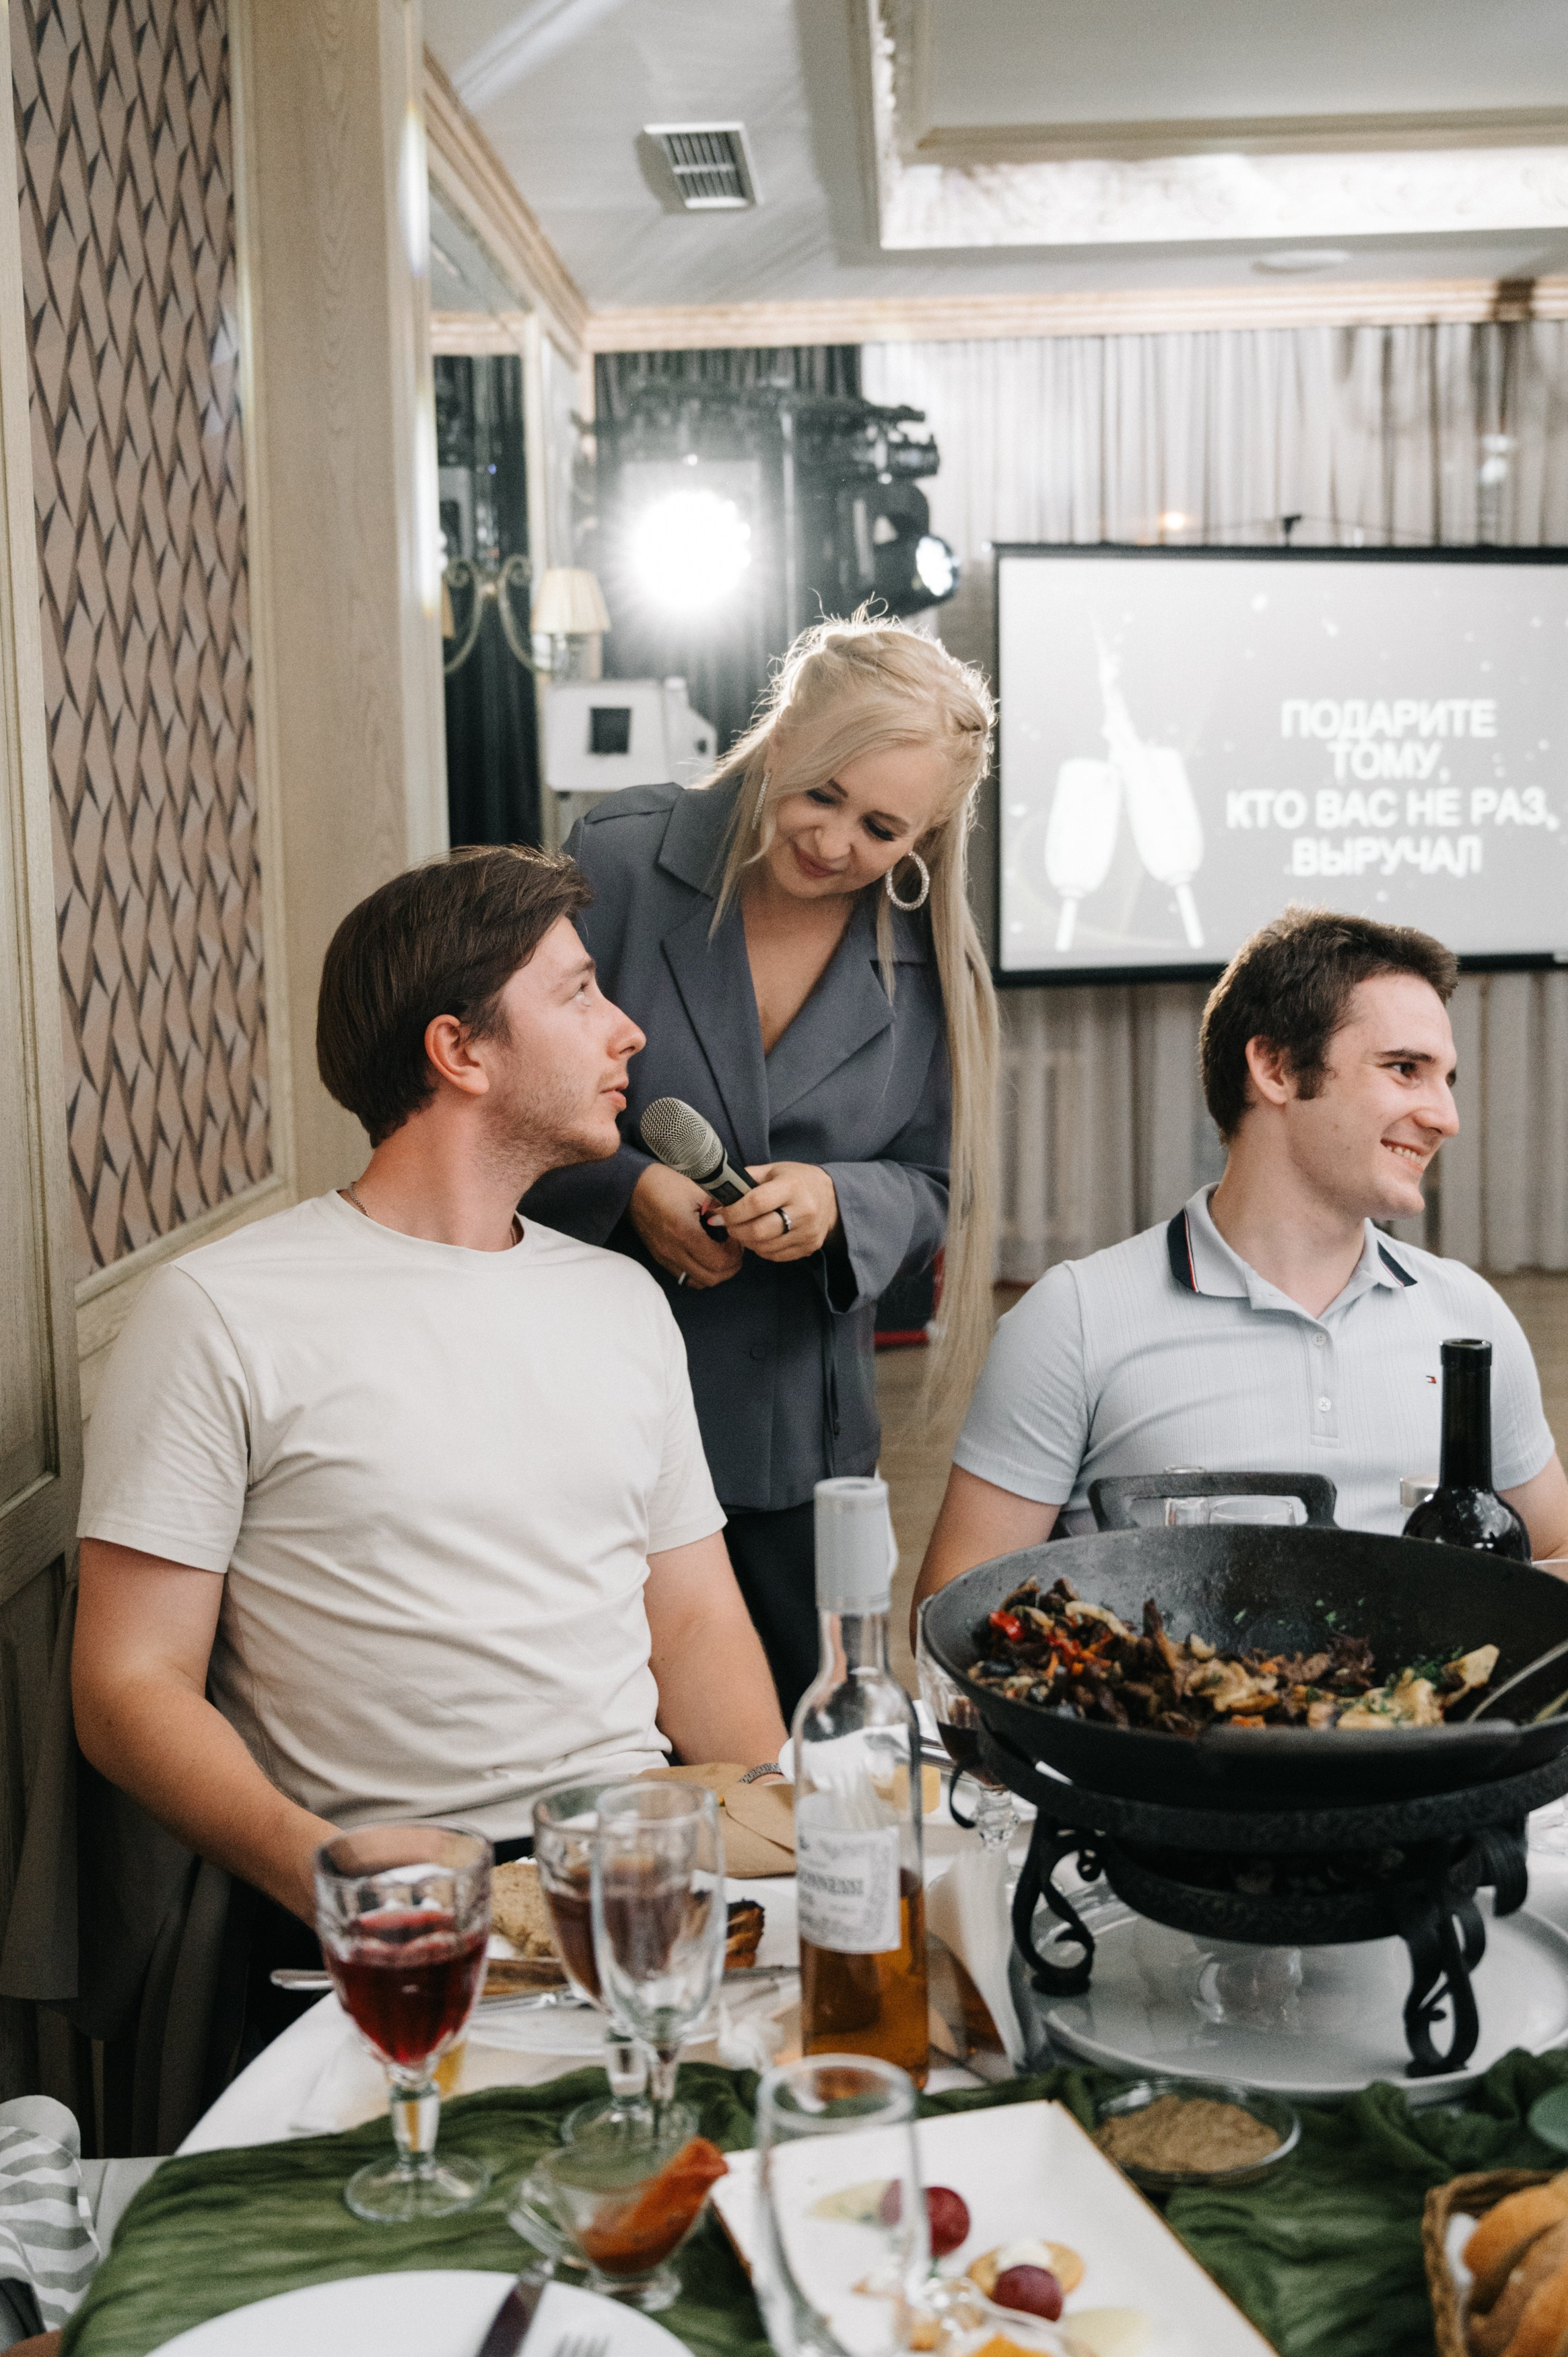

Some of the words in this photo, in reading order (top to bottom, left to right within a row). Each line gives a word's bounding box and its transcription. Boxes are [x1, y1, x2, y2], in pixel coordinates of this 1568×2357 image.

[1279, 698, 1497, 740] ПОДАРИТЕ
[1226, 789, 1308, 829] КТО
[1316, 789, 1398, 829] ВАС
[1406, 788, 1461, 827] НЕ
[1291, 835, 1482, 877] ВЫРУЧАЛ
